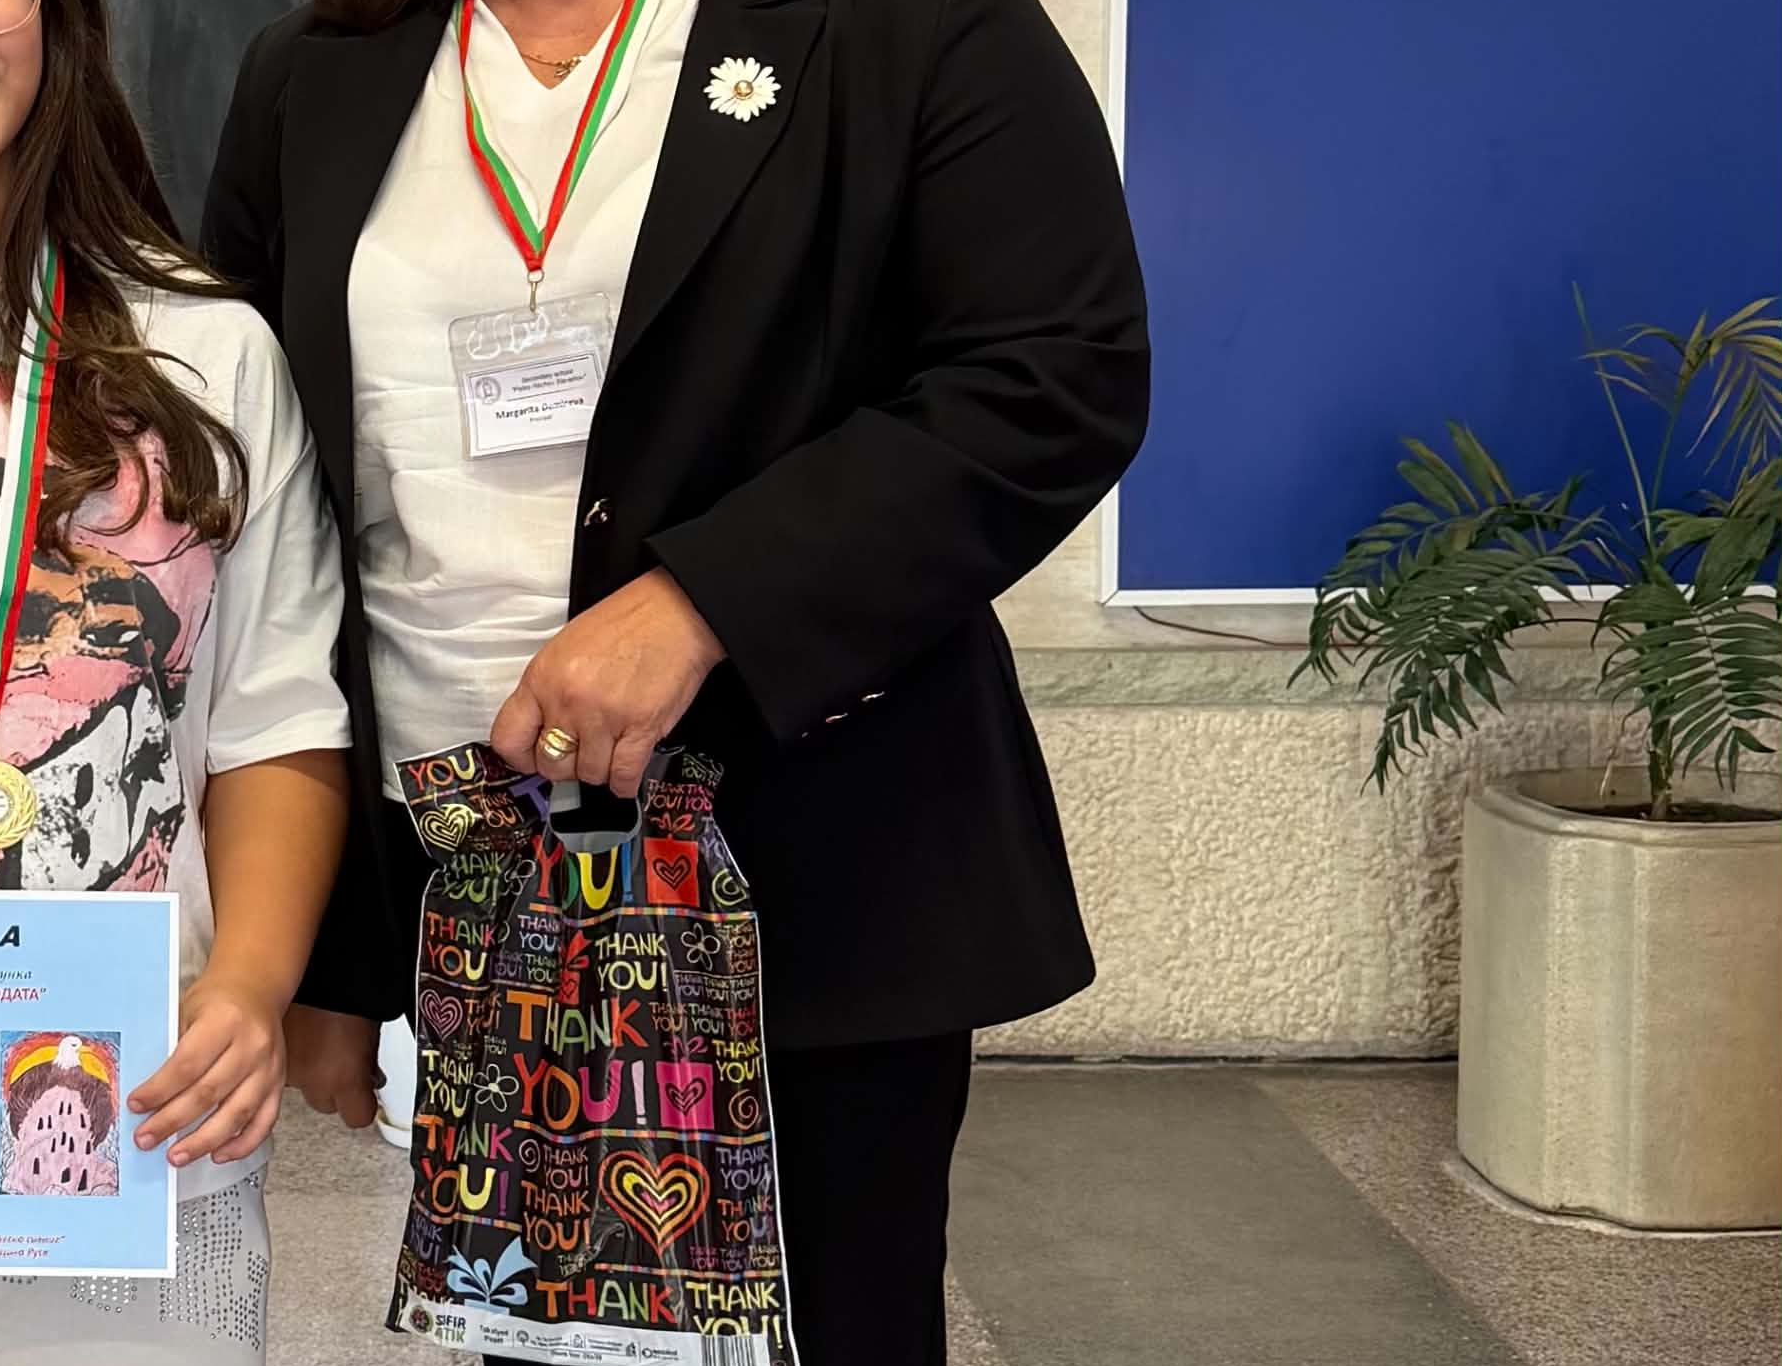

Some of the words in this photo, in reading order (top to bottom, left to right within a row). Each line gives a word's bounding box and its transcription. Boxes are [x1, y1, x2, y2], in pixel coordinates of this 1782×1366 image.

[426, 911, 498, 947] THANK
[594, 932, 668, 960] THANK
[426, 940, 488, 981] YOU
[597, 959, 668, 992] YOU!
[506, 989, 650, 1055] THANK
[715, 1057, 762, 1084] YOU!
[513, 1052, 647, 1131] YOU!
[543, 1144, 589, 1166] THANK
[714, 1145, 771, 1166] THANK
[545, 1165, 590, 1190] YOU!
[521, 1179, 592, 1218] THANK
[522, 1211, 592, 1252] YOU!
[536, 1277, 678, 1324] THANK
[685, 1281, 780, 1312] THANK
